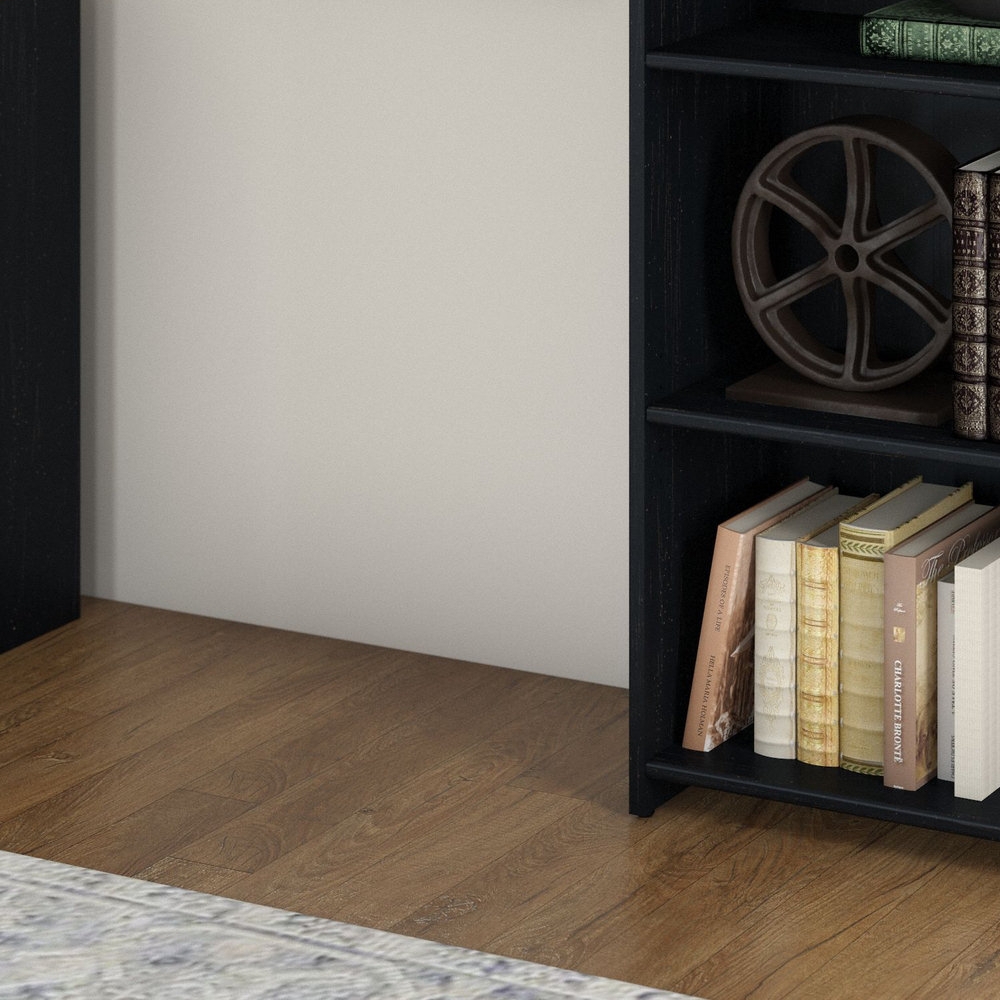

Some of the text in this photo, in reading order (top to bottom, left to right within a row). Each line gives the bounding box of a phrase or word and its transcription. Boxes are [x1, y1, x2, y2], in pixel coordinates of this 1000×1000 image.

[720, 564, 731, 598] EPISODES
[718, 598, 725, 610] OF
[715, 616, 723, 633] LIFE
[702, 678, 712, 703] MARIA
[697, 704, 708, 737] HOLMAN
[893, 659, 904, 764] CHARLOTTE BRONTË
